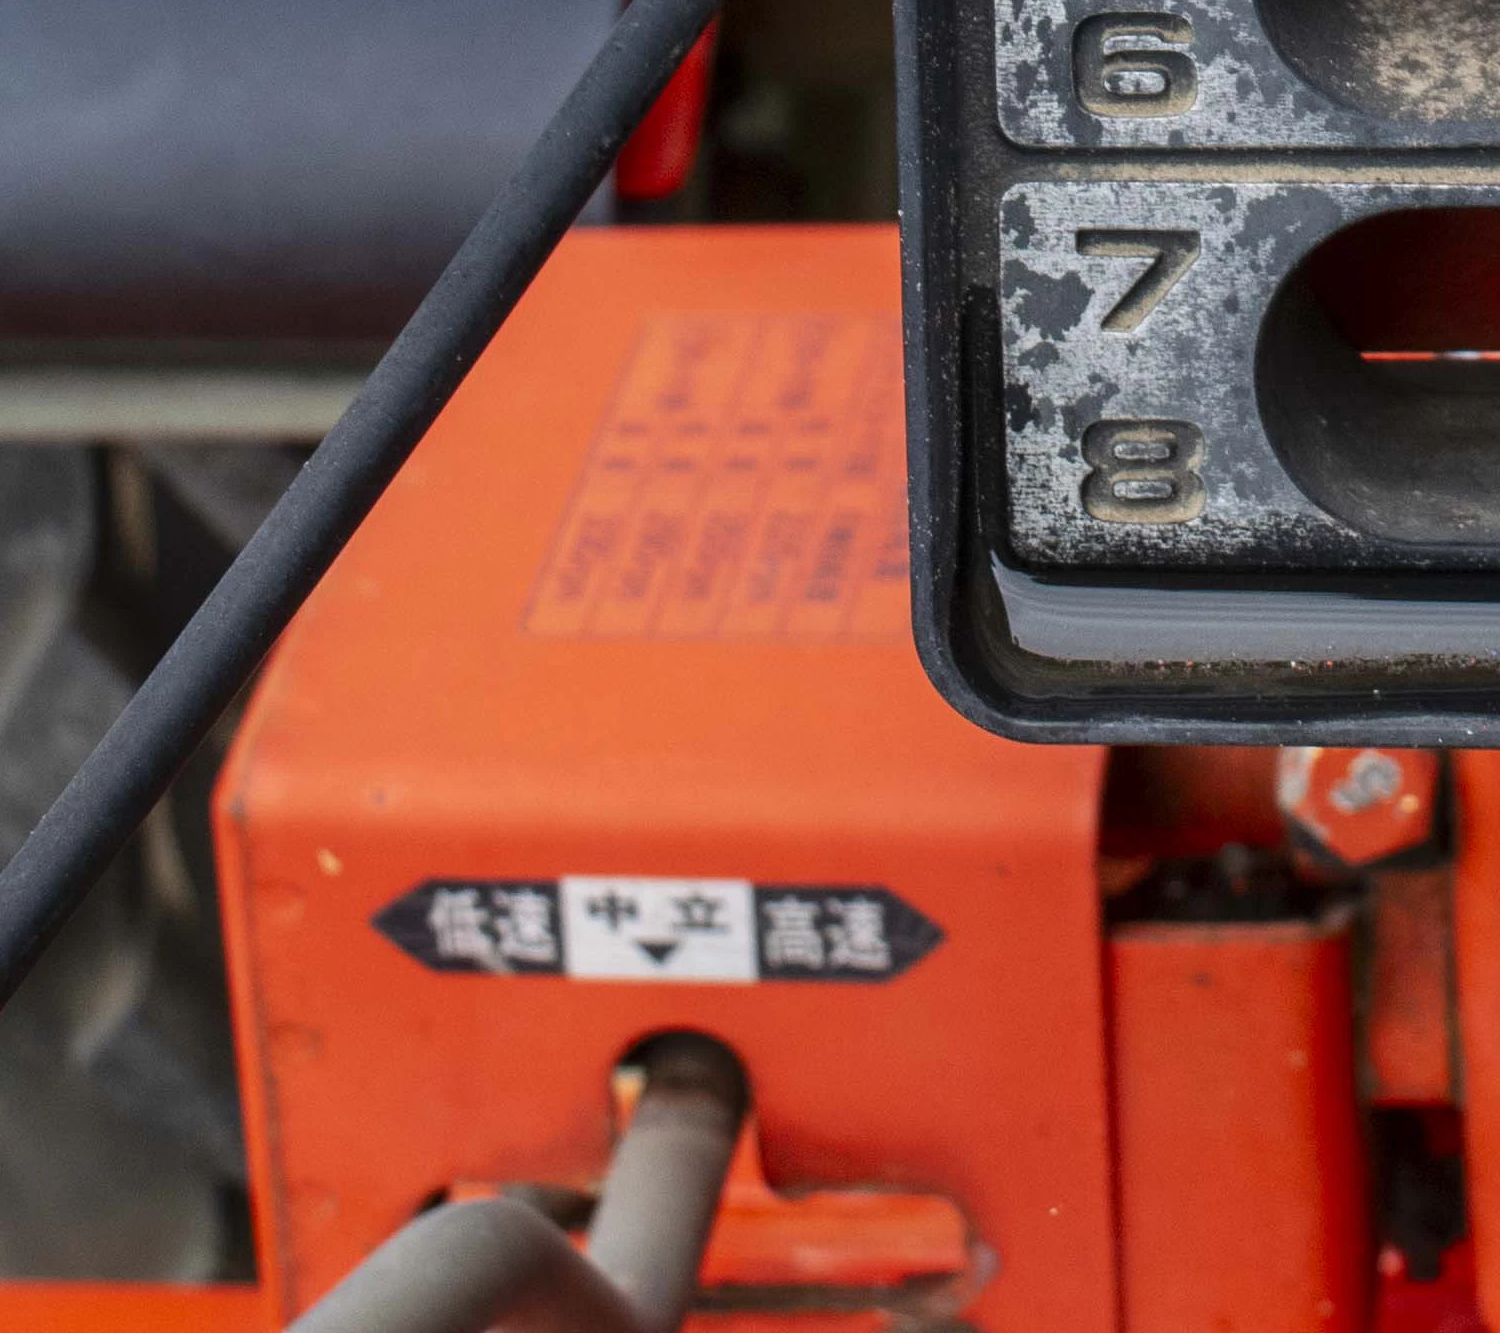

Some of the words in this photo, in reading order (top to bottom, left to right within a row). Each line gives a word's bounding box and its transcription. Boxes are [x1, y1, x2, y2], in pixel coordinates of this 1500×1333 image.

[1071, 11, 1198, 118] 6
[1075, 229, 1201, 333] 7
[1080, 418, 1206, 524] 8
[427, 886, 559, 965] 低速
[588, 887, 728, 933] 中立
[764, 894, 892, 971] 高速
